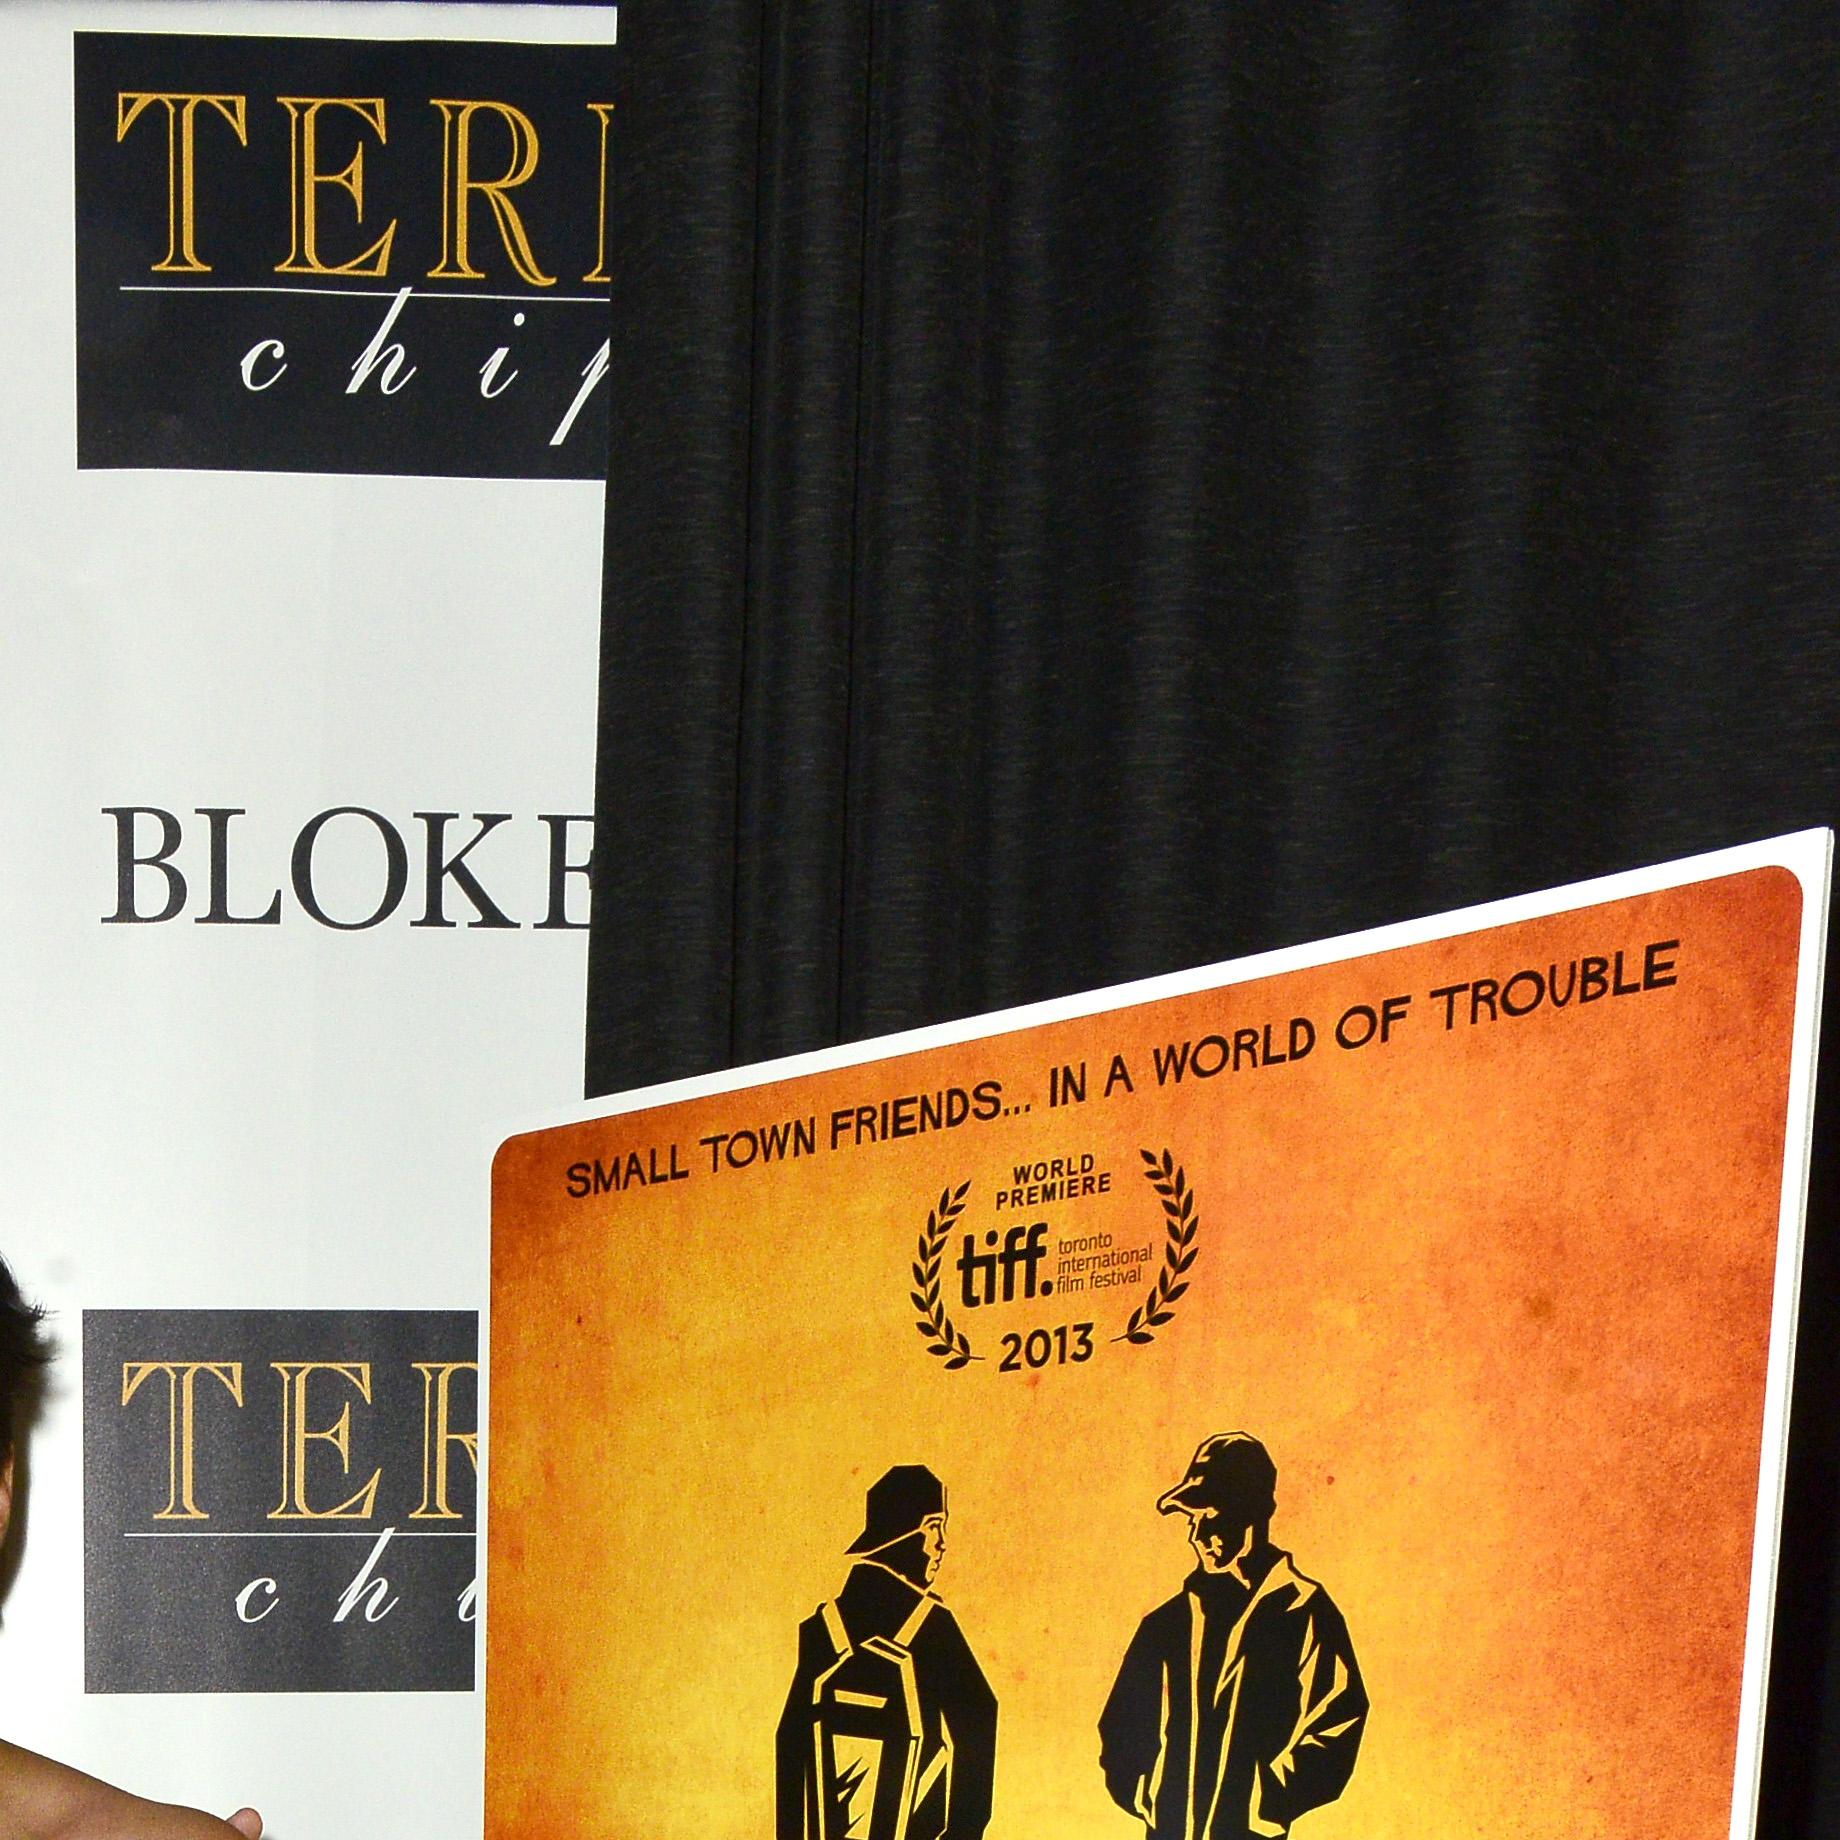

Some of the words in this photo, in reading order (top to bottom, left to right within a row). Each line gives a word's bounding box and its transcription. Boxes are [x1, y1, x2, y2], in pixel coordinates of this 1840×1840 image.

[116, 92, 615, 287] TER
[565, 1142, 690, 1199] SMALL
[699, 1116, 817, 1174] TOWN
[1048, 1061, 1088, 1108] IN
[1103, 1053, 1135, 1098] A
[1152, 1017, 1316, 1086] WORLD
[1334, 994, 1412, 1051] OF
[1428, 938, 1681, 1031] TROUBLE
[1013, 1153, 1094, 1185] WORLD
[995, 1172, 1111, 1211] PREMIERE
[1057, 1242, 1153, 1275] international
[1058, 1232, 1113, 1255] toronto
[1057, 1275, 1084, 1295] film
[1089, 1266, 1142, 1290] festival
[998, 1322, 1094, 1373] 2013
